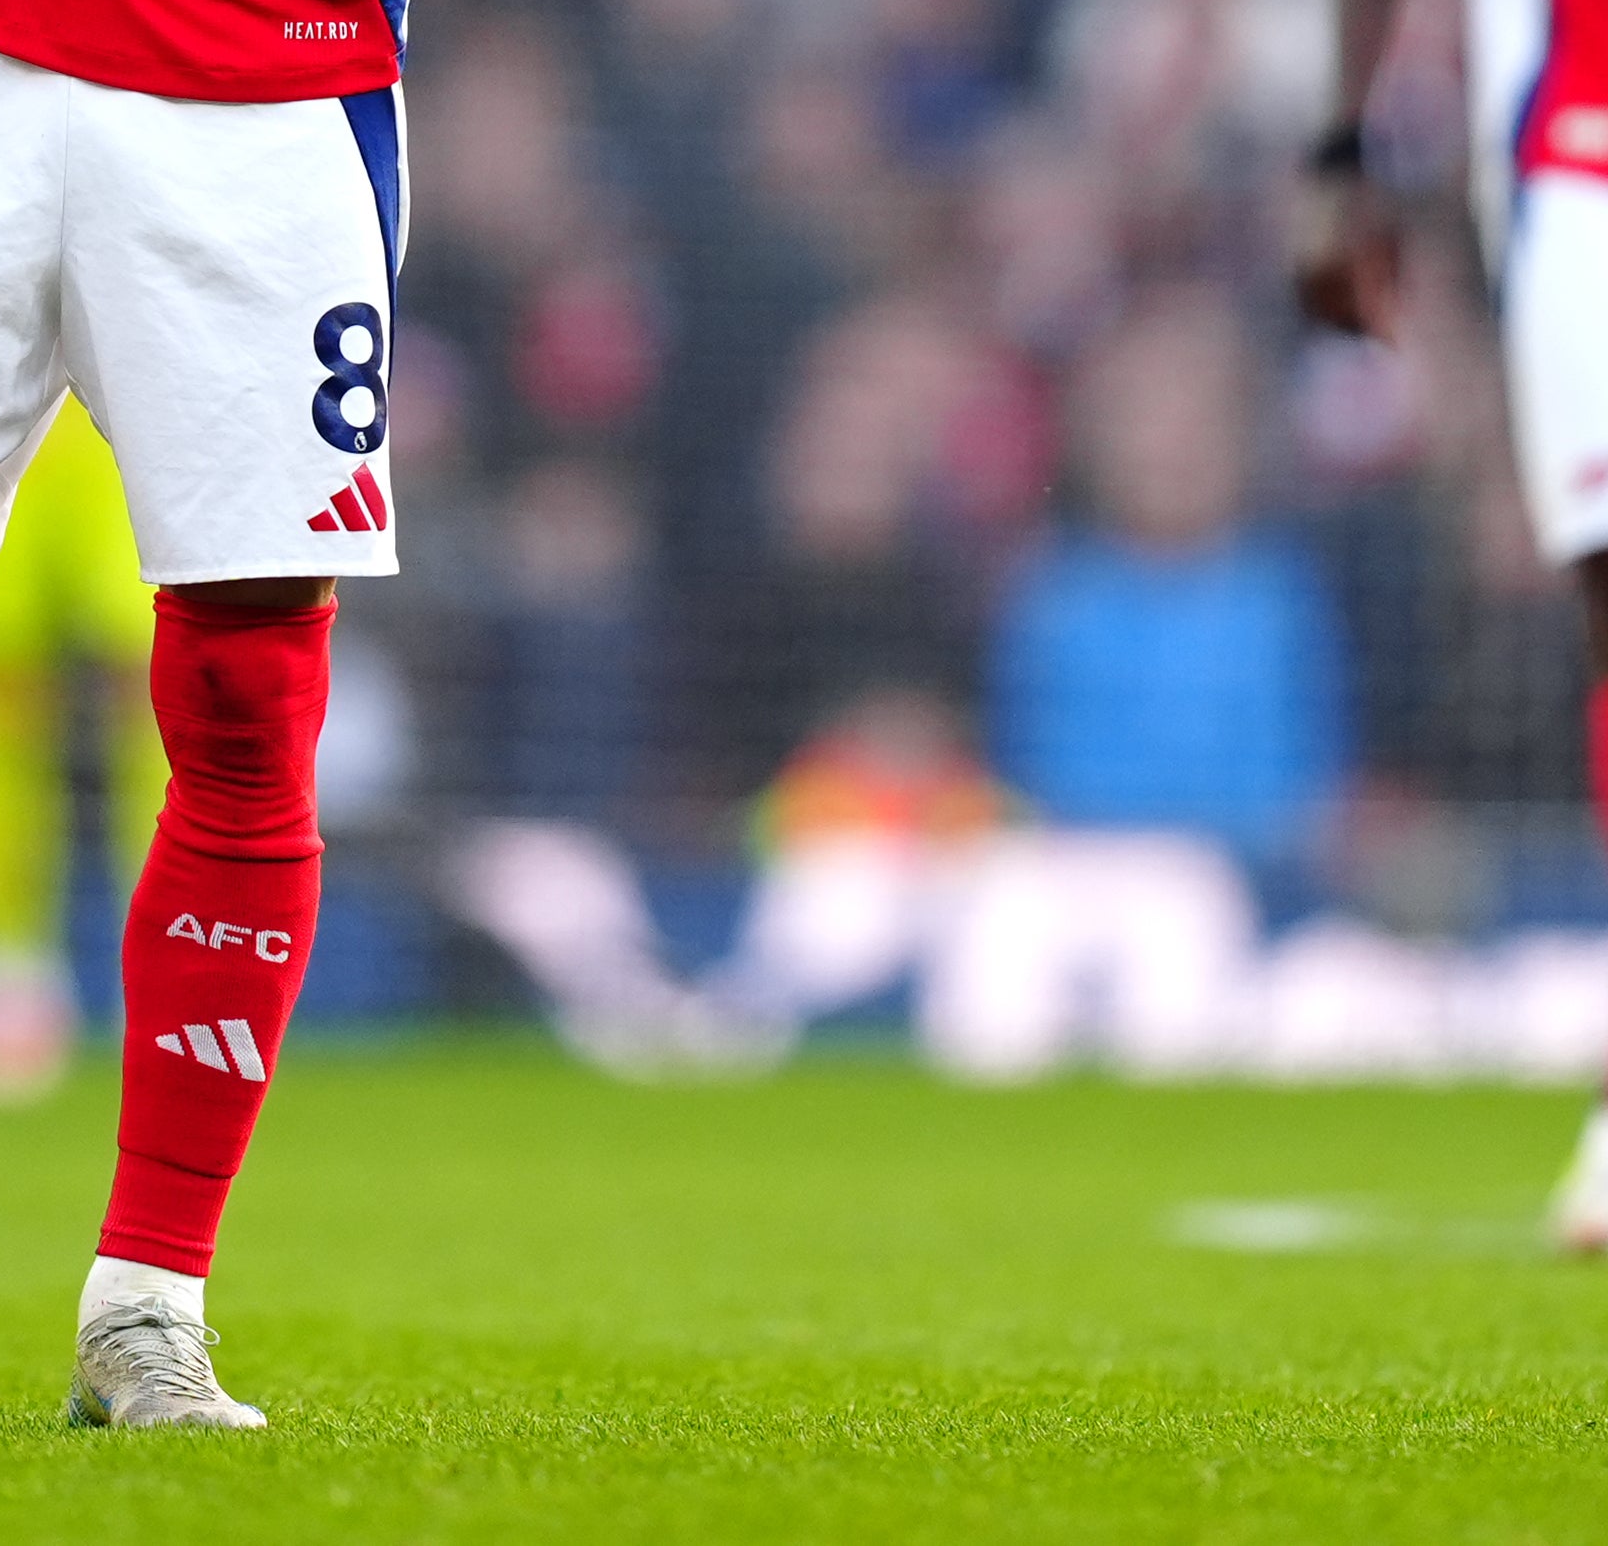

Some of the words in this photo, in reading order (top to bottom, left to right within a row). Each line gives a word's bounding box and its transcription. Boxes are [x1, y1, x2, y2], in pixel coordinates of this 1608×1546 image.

[283, 21, 359, 40] HEAT.RDY
[311, 301, 387, 455] 8
[166, 912, 292, 964] AFC
